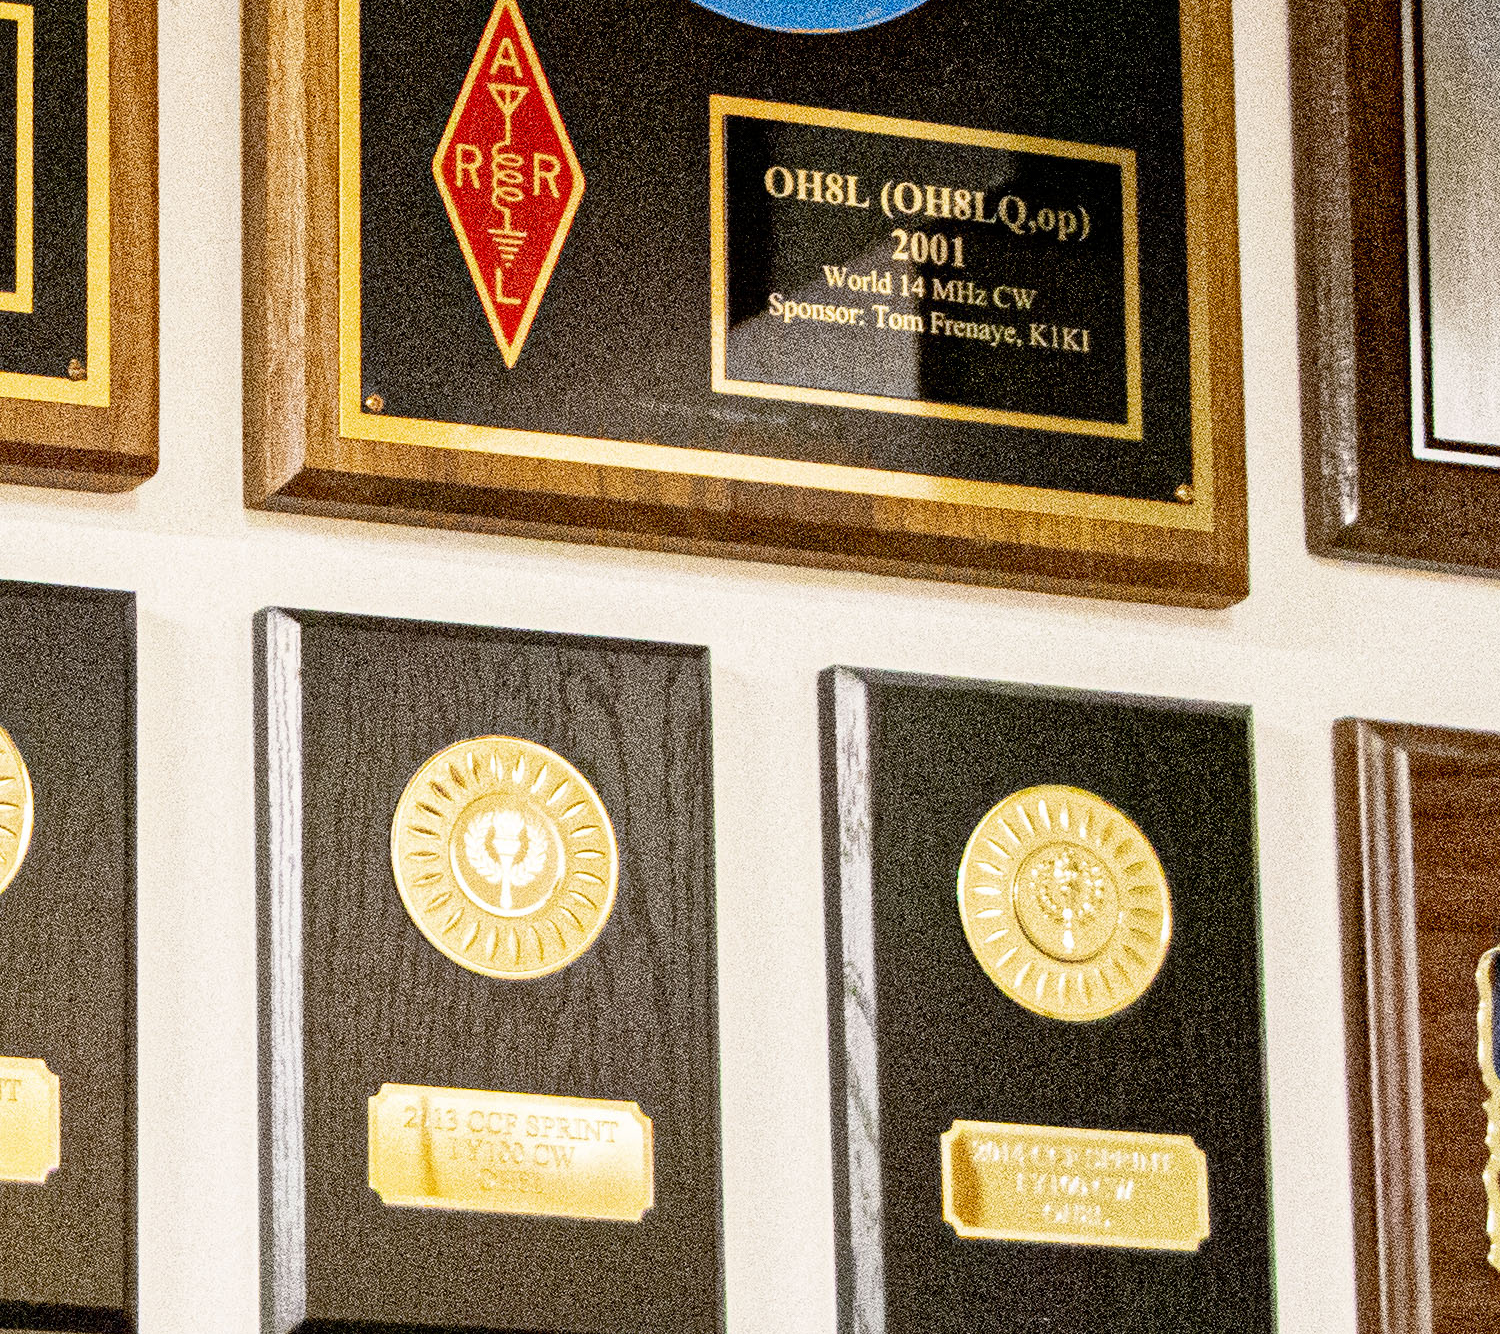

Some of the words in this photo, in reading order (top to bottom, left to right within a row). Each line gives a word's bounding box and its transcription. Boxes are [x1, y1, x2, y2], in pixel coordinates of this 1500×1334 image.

[764, 166, 870, 209] OH8L
[879, 179, 1091, 242] (OH8LQ,op)
[891, 228, 966, 267] 2001
[823, 264, 892, 297] World
[900, 274, 925, 297] 14
[931, 278, 988, 307] MHz
[992, 286, 1038, 311] CW
[768, 292, 866, 327] Sponsor:
[871, 304, 924, 332] Tom
[930, 311, 1023, 348] Frenaye,
